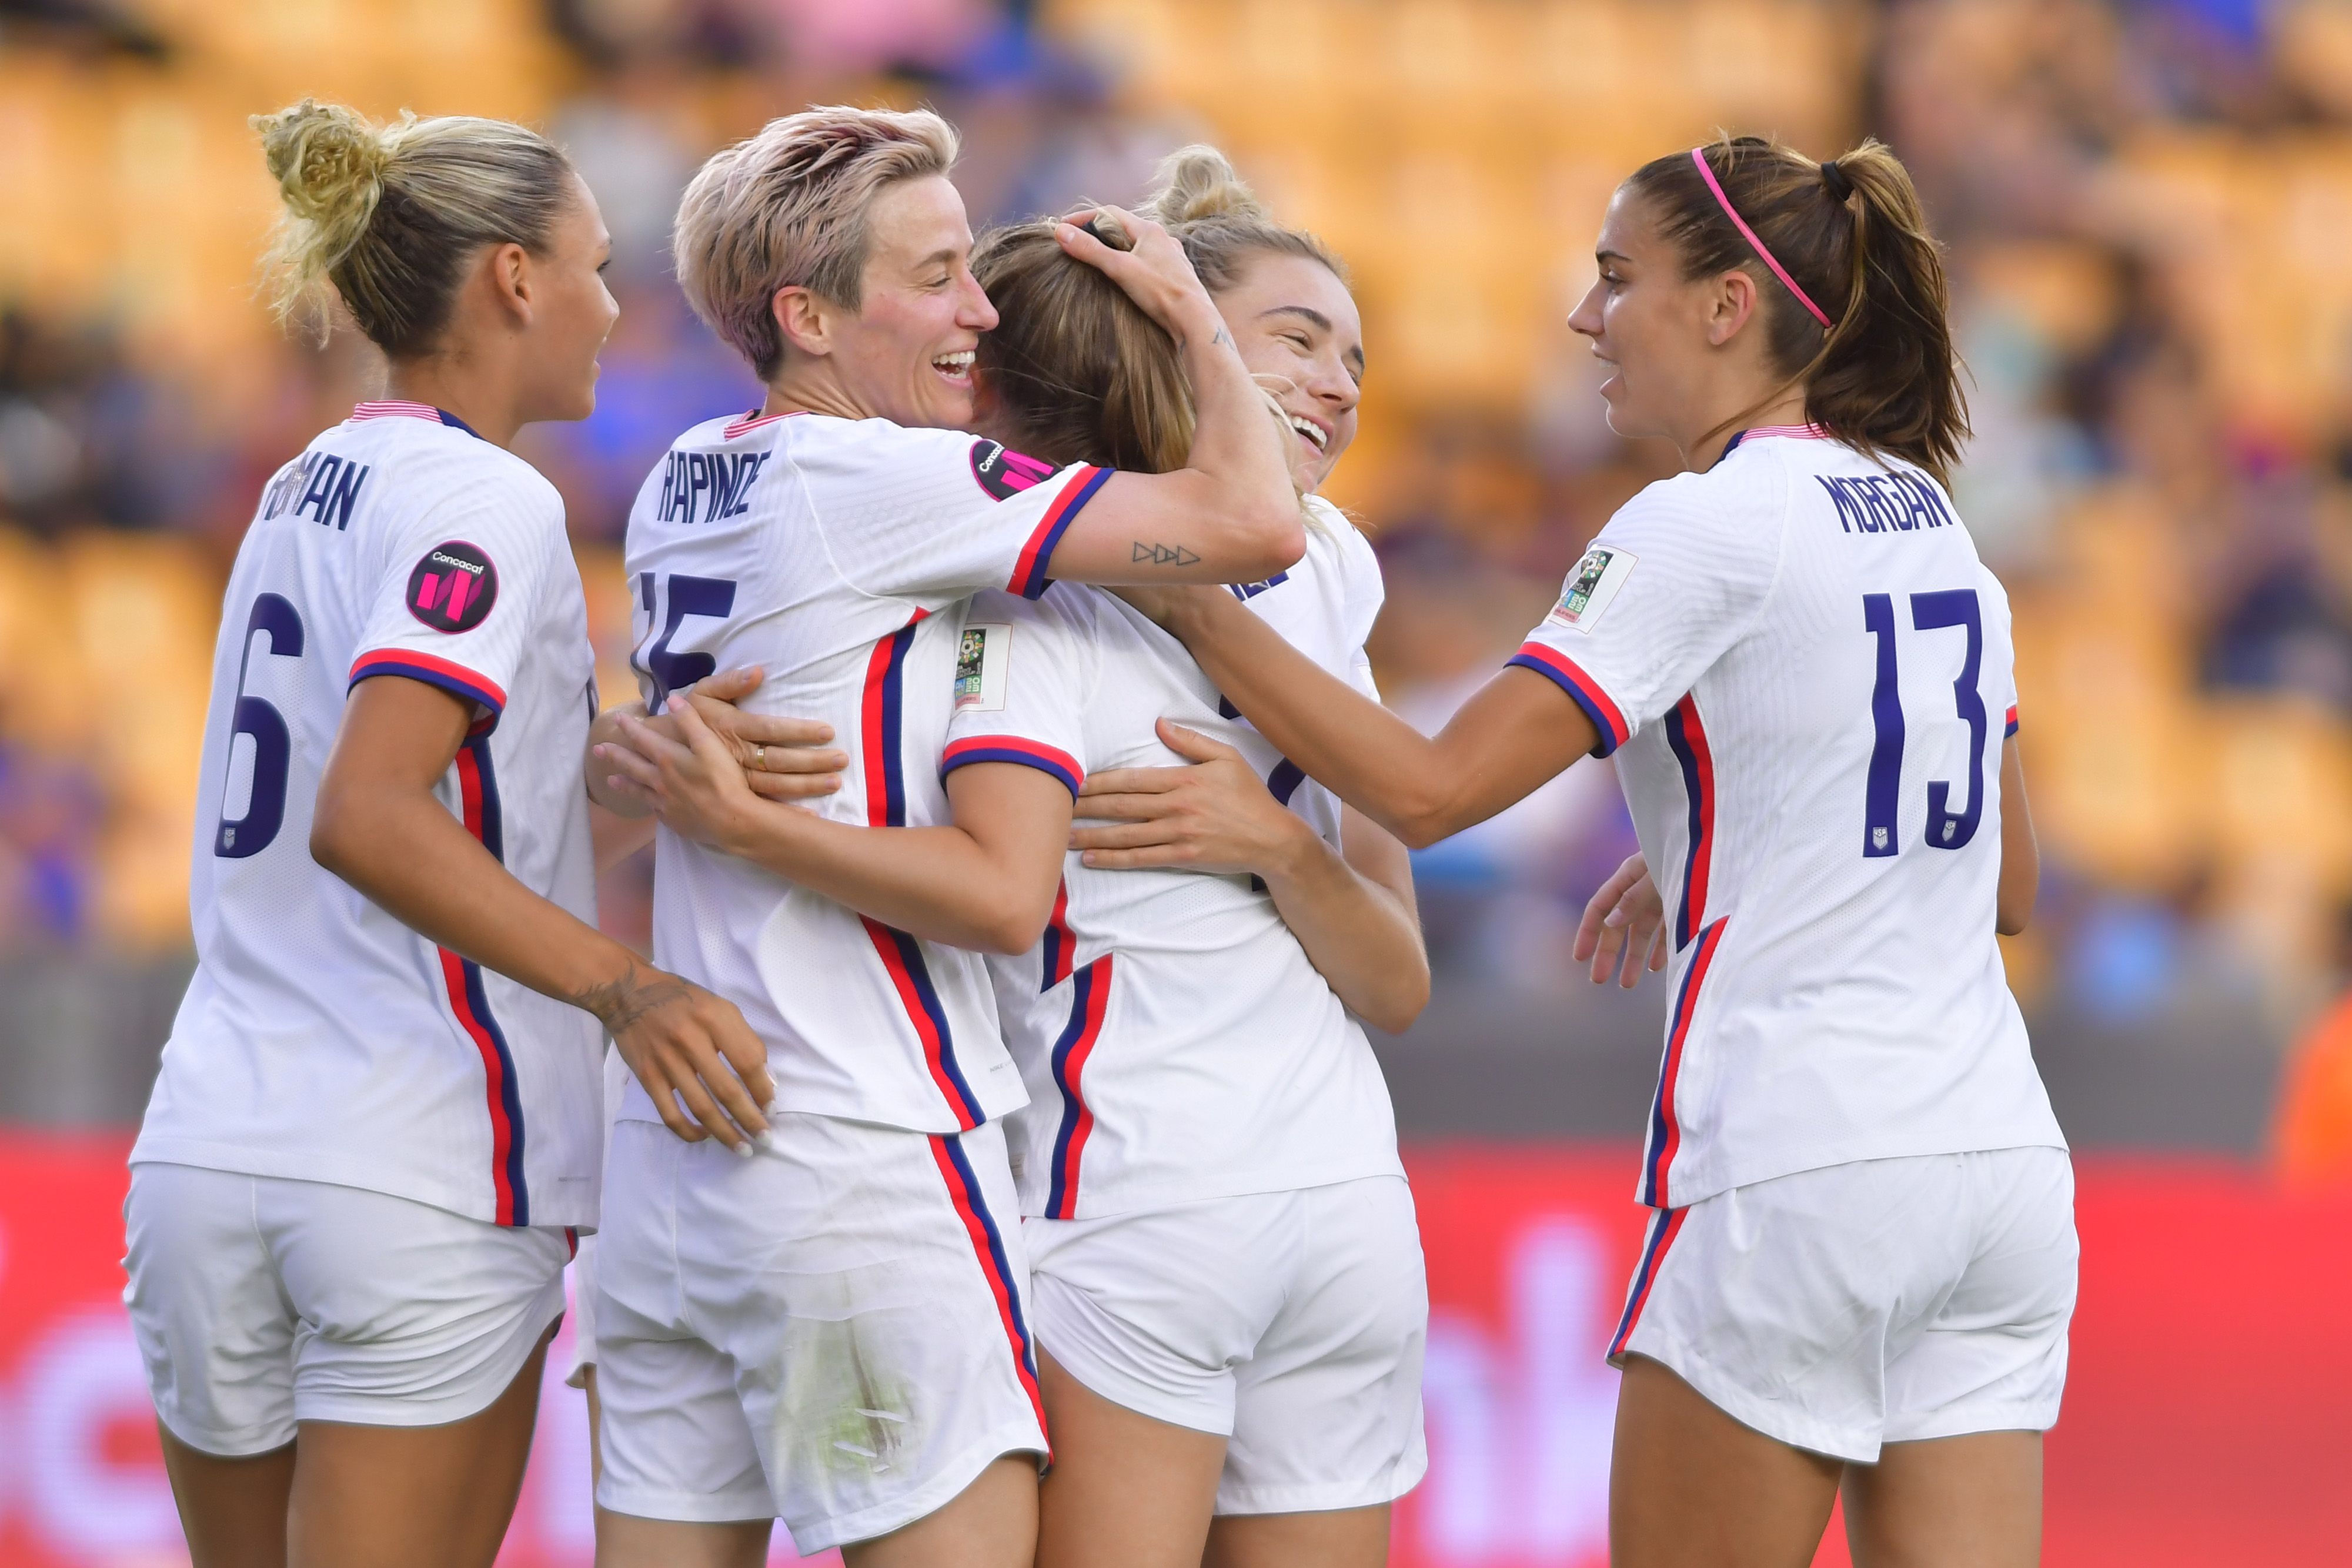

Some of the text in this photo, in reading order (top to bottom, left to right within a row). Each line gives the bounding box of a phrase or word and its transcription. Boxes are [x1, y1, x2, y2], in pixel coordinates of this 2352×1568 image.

[657, 449, 773, 523] RAPINOE
[1813, 470, 1953, 533] MORGAN
[432, 551, 484, 574] Concacaf
[214, 592, 305, 858] 6
[1862, 589, 1987, 857] 13
[1873, 828, 1887, 837] USA
